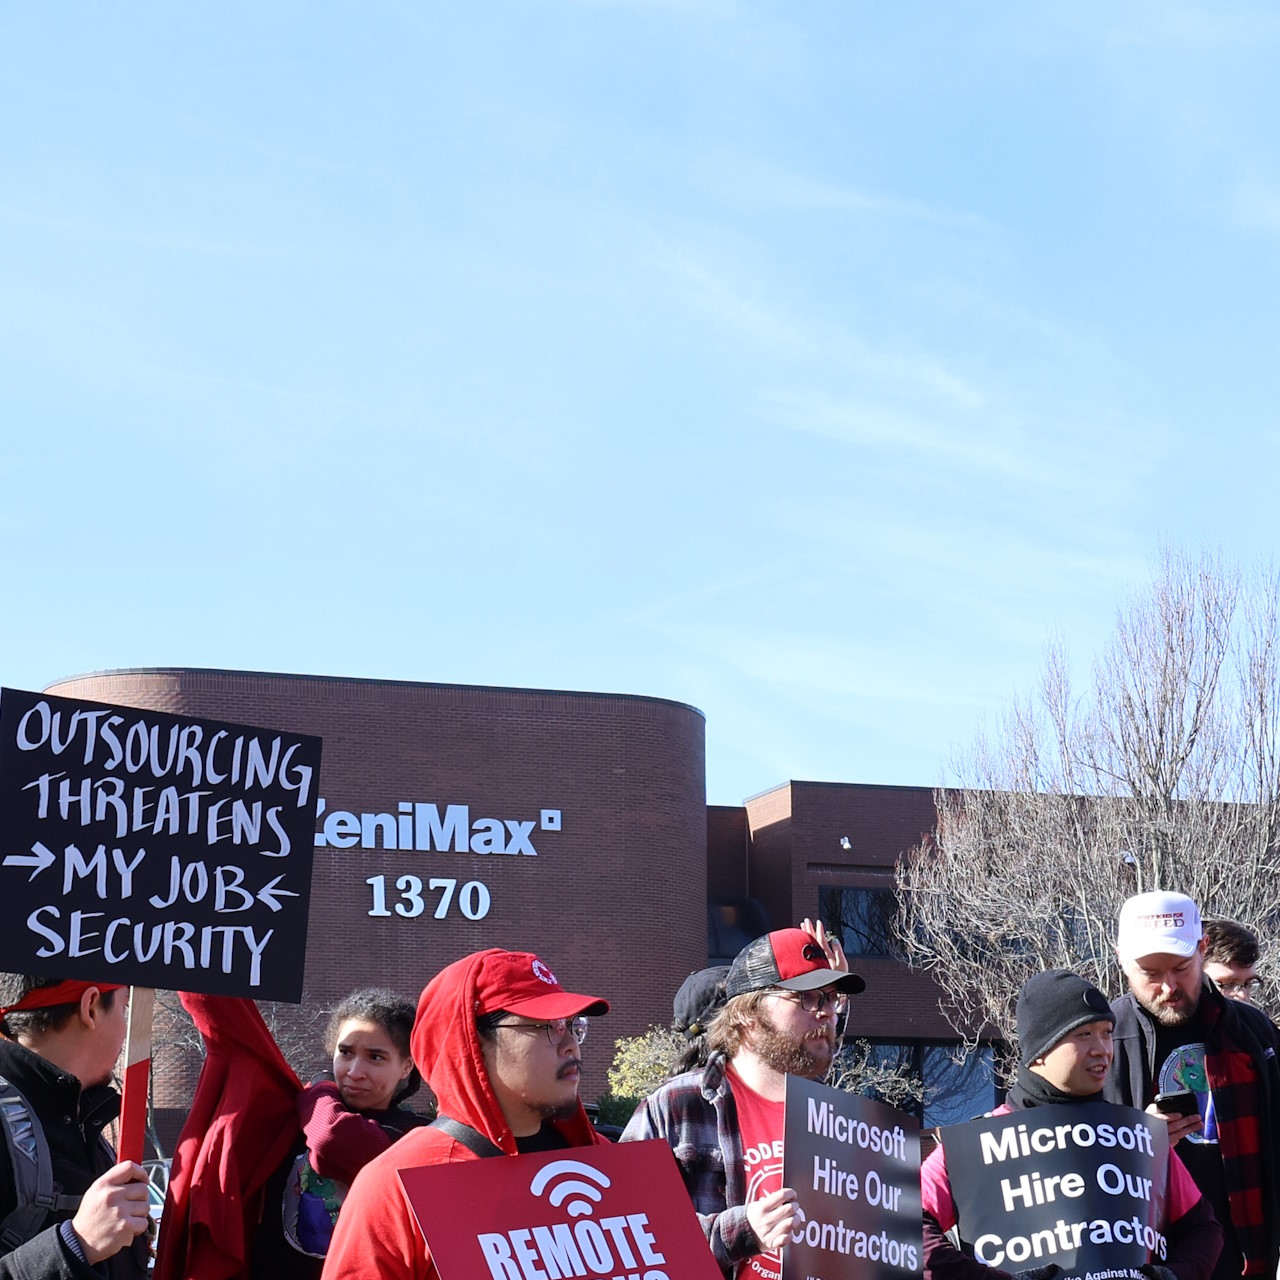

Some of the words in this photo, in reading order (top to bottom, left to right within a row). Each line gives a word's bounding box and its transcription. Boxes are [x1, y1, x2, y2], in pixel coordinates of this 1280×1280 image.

[16, 701, 313, 807] OUTSOURCING
[21, 771, 291, 857] THREATENS
[62, 844, 146, 899] MY
[148, 855, 255, 913] JOB
[366, 874, 491, 921] 1370
[26, 905, 274, 986] SECURITY
[807, 1097, 906, 1161] Microsoft
[979, 1122, 1155, 1165] Microsoft
[813, 1155, 859, 1201] Hire
[865, 1170, 902, 1212] Our
[1000, 1171, 1086, 1213] Hire
[1096, 1163, 1152, 1202] Our
[791, 1207, 918, 1271] Contractors
[973, 1215, 1167, 1267] Contractors
